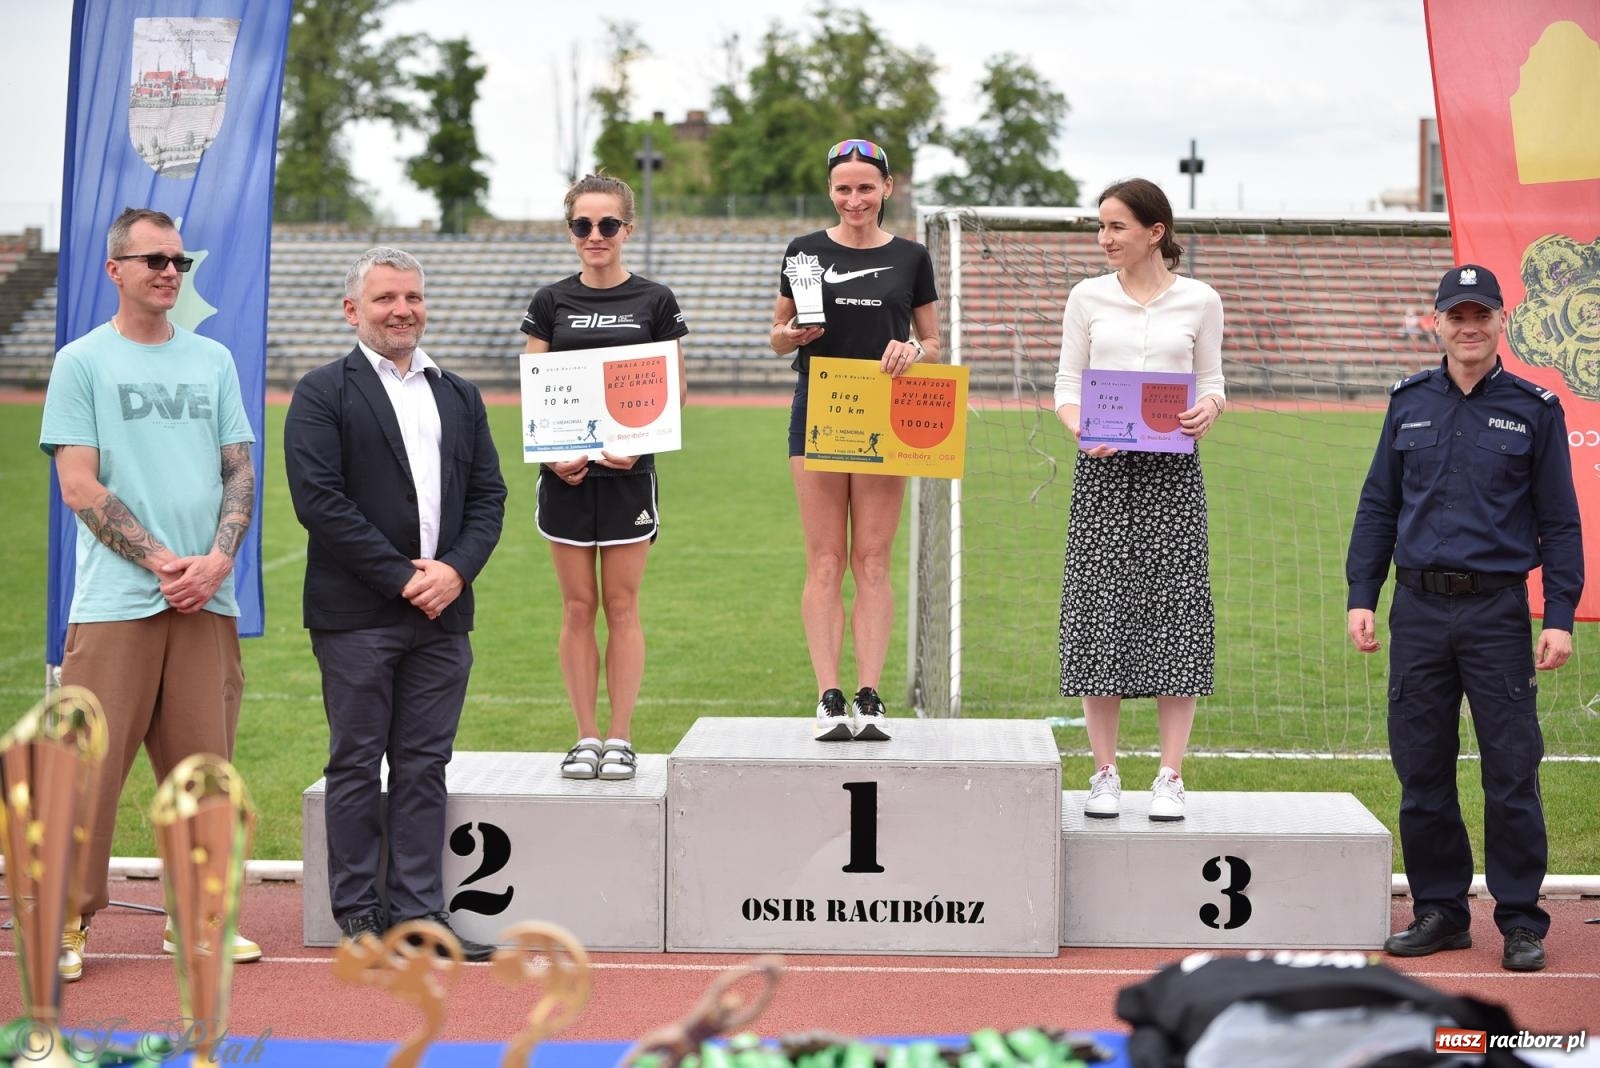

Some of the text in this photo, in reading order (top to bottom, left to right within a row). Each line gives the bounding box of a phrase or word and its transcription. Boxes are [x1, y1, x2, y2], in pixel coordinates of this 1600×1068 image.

[835, 297, 883, 307] ERIGO
[629, 377, 664, 388] GRANIC
[545, 384, 573, 393] Bieg
[544, 397, 580, 406] 10 km
[831, 391, 859, 403] Bieg
[916, 399, 952, 408] GRANIC
[829, 405, 865, 415] 10 km
[1488, 417, 1526, 434] POLICJA
[634, 518, 654, 526] adidas
[842, 781, 885, 873] 1
[449, 821, 514, 916] 2
[1199, 855, 1252, 930] 3
[741, 894, 985, 924] OSIR RACIBÓRZ
